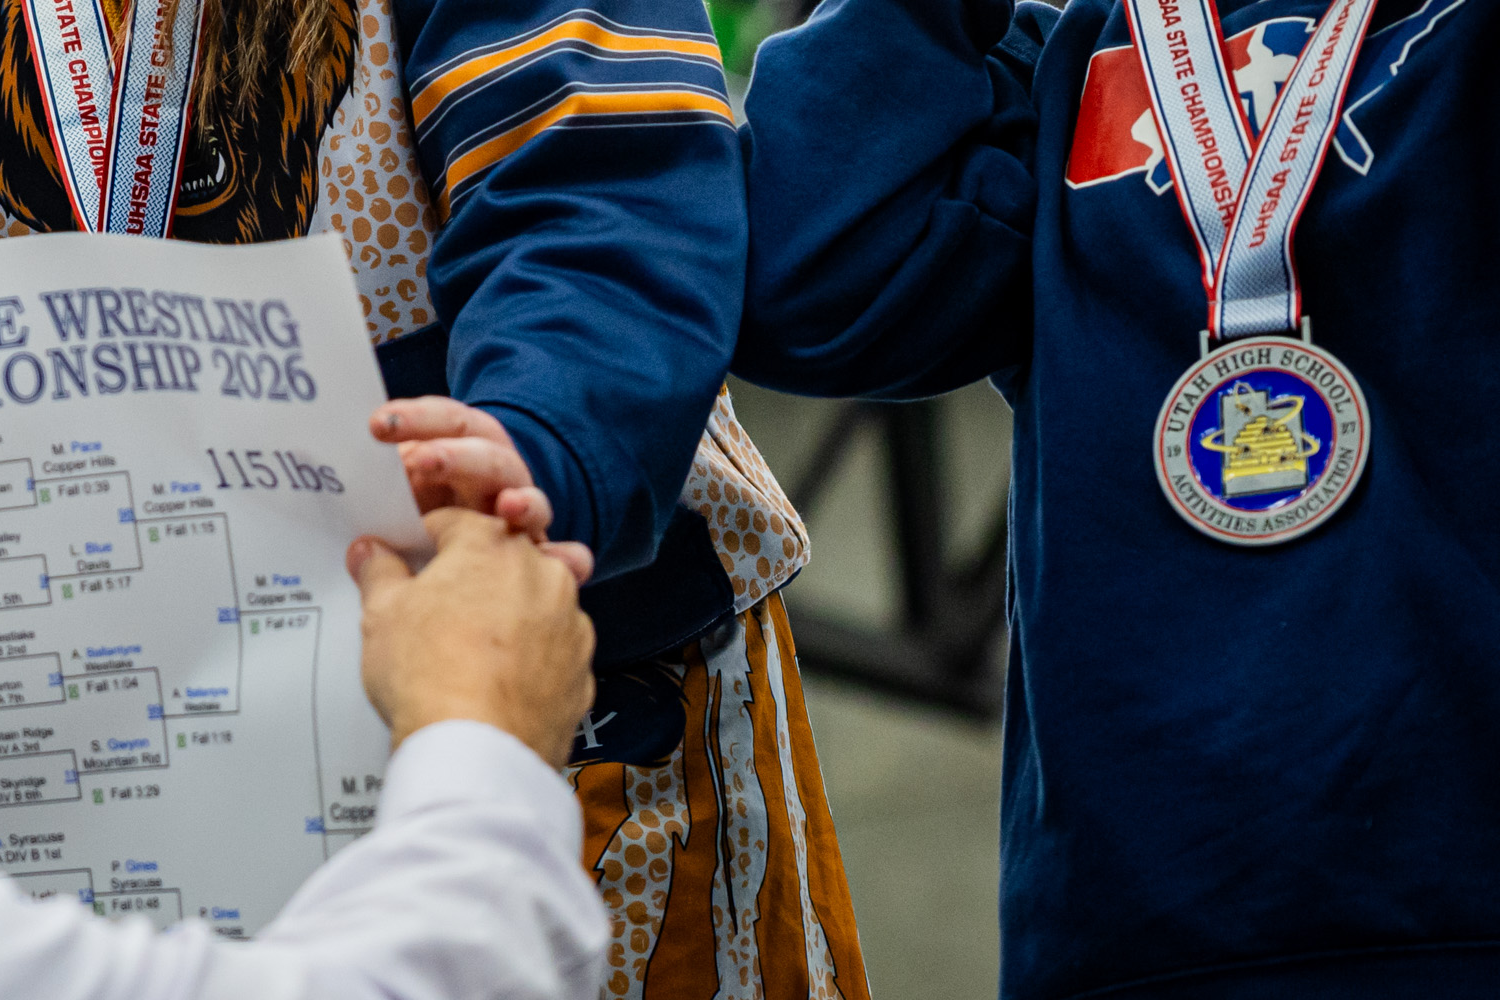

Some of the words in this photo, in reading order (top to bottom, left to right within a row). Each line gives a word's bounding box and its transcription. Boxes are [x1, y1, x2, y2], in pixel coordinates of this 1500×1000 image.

[1166, 31, 1195, 80] STATE
[69, 59, 105, 190] CHAMPION
[140, 75, 167, 147] STATE
[1180, 82, 1236, 228] CHAMPIONSH
[1249, 168, 1291, 248] UHSAA
[1279, 93, 1317, 163] STATE
[127, 154, 154, 235] UHSAA
[40, 287, 300, 349] WRESTLING
[213, 352, 316, 401] 2026
[1167, 374, 1211, 434] UTAH
[1213, 348, 1272, 378] HIGH
[1280, 349, 1352, 414] SCHOOL
[42, 459, 87, 473] Copper
[91, 454, 116, 466] Hills
[71, 441, 101, 453] Pace
[206, 447, 279, 489] 115
[58, 483, 81, 495] Fall
[1171, 472, 1257, 532] ACTIVITIES
[1263, 446, 1355, 532] ASSOCIATION
[85, 542, 112, 554] Blue
[81, 580, 103, 593] Fall
[87, 679, 110, 693] Fall
[110, 787, 132, 799] Fall
[6, 850, 27, 863] DIV
[31, 849, 41, 861] B
[9, 832, 65, 847] Syracuse
